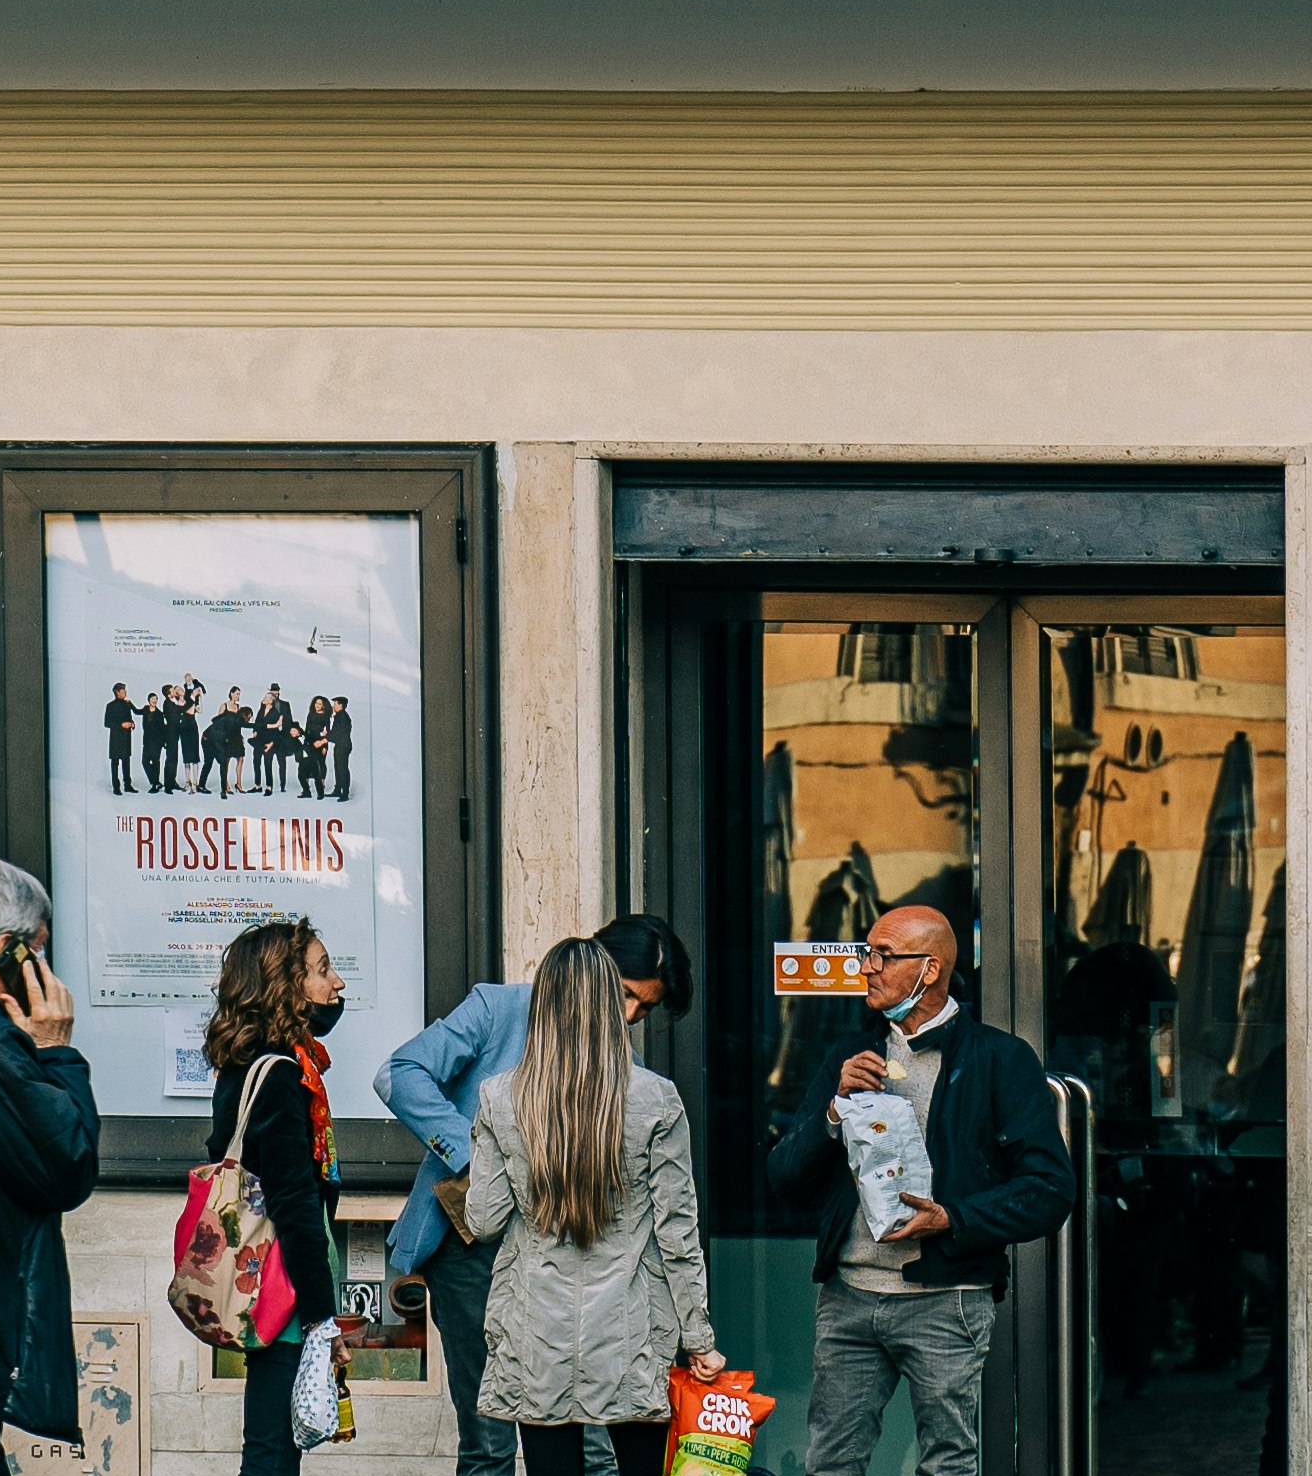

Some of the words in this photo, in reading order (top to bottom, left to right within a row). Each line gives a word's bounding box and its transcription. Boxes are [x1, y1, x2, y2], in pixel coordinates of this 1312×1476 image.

[116, 816, 134, 833] THE
[136, 816, 344, 873] ROSSELLINIS
[141, 874, 161, 882] UNA
[166, 874, 210, 883] FAMIGLIA
[214, 875, 232, 883] CHE
[246, 875, 275, 884] TUTTA
[279, 876, 293, 884] UN
[702, 1392, 752, 1417] CRIK
[697, 1410, 755, 1438] CROK
[31, 1444, 81, 1459] GAS
[710, 1448, 732, 1463] PEPE
